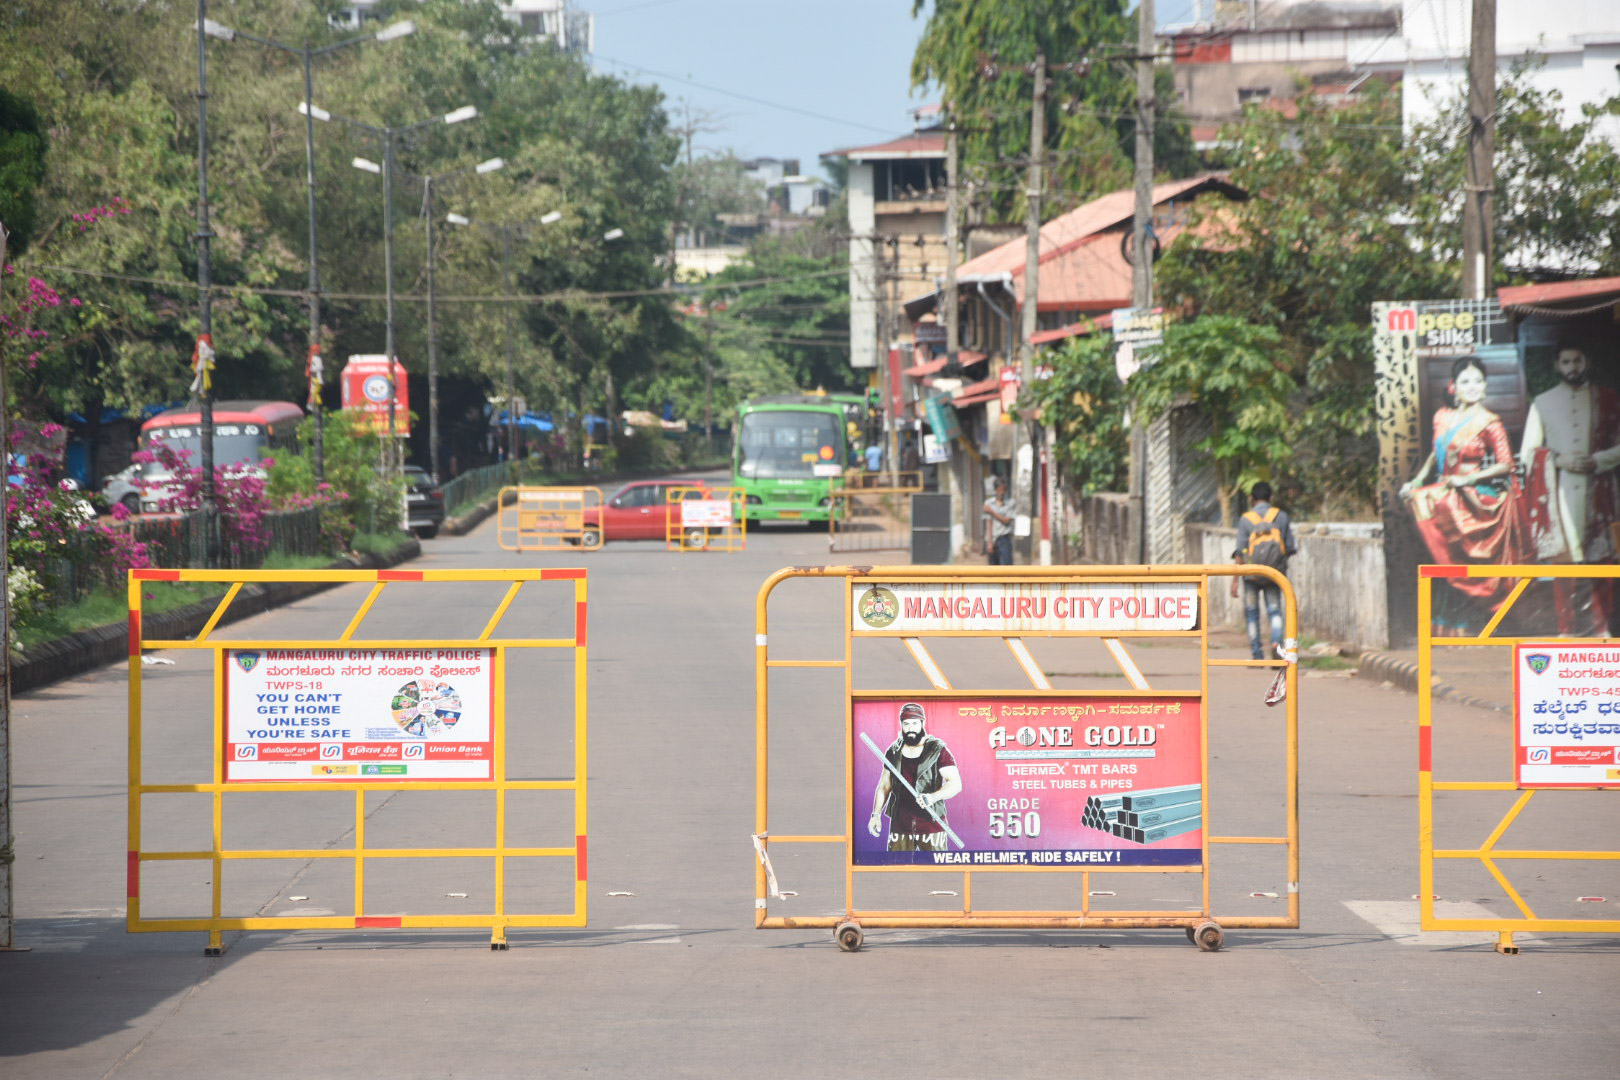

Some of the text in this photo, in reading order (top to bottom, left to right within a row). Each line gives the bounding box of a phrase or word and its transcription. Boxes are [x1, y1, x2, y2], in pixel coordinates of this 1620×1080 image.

[1427, 327, 1475, 346] Silks
[904, 597, 1191, 619] MANGALURU CITY POLICE
[266, 650, 481, 661] MANGALURU CITY TRAFFIC POLICE
[266, 665, 335, 676] ಮಂಗಳೂರು
[341, 665, 372, 676] ನಗರ
[378, 664, 424, 676] ಸಂಚಾರಿ
[265, 681, 323, 690] TWPS-18
[256, 693, 342, 703] YOU CAN'T
[256, 705, 341, 715] GET HOME
[267, 717, 331, 727] UNLESS
[247, 729, 351, 739] YOU'RE SAFE
[988, 725, 1074, 749] A-ONE
[1084, 725, 1157, 748] GOLD
[429, 745, 483, 753] Union Bank
[1072, 764, 1099, 775] TMT
[1102, 764, 1138, 775] BARS
[1012, 779, 1133, 790] STEEL TUBES & PIPES
[987, 798, 1041, 810] GRADE
[989, 812, 1042, 839] 550
[933, 853, 971, 864] WEAR
[974, 853, 1028, 865] HELMET,
[1031, 852, 1062, 863] RIDE
[1065, 852, 1113, 863] SAFELY
